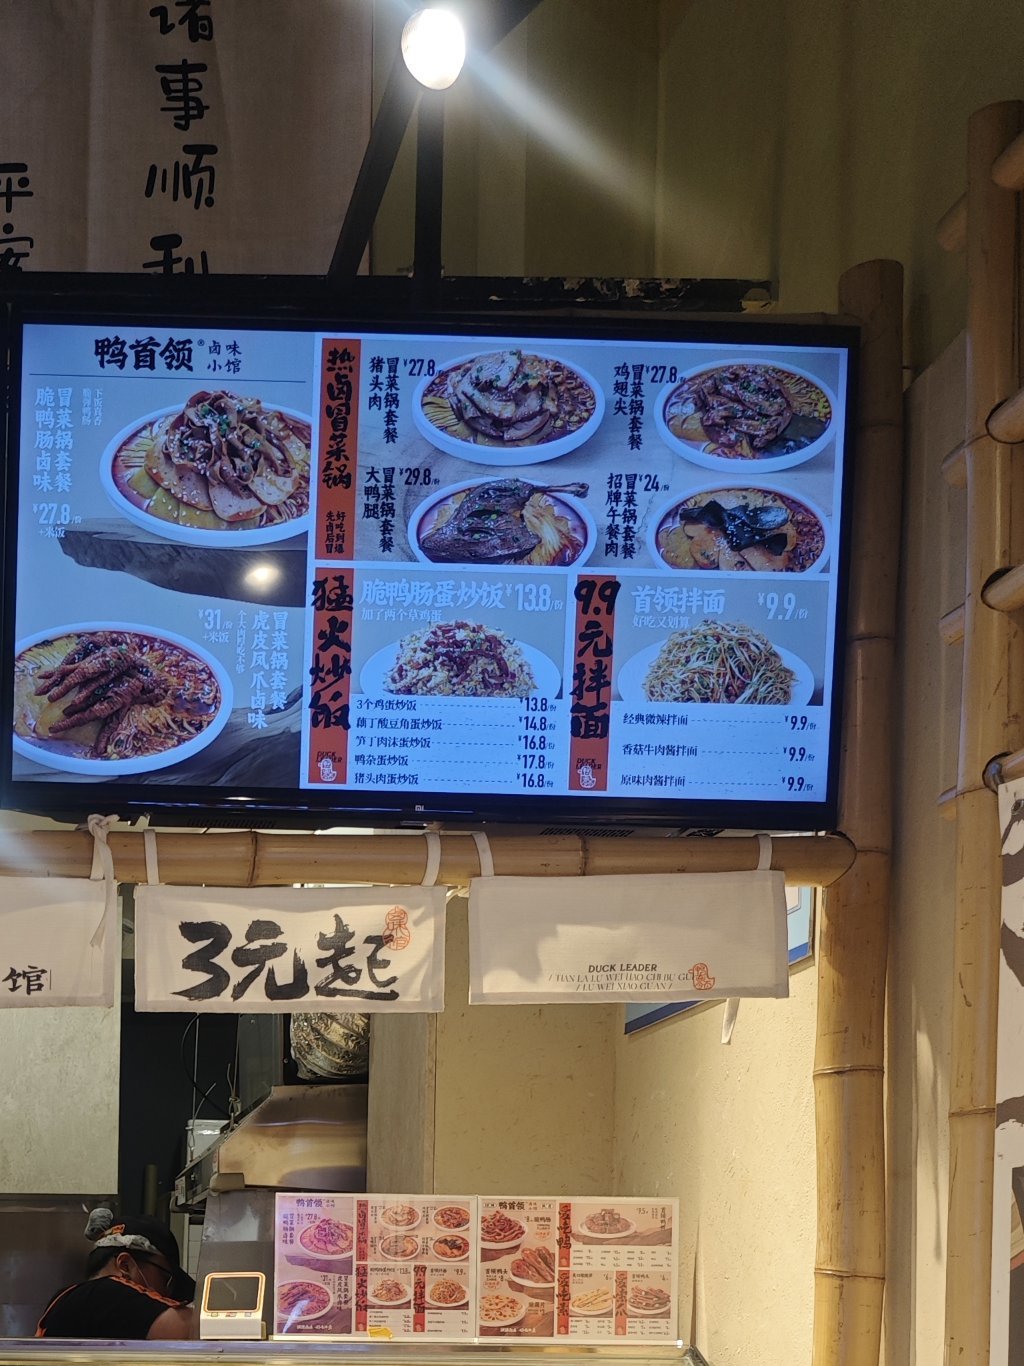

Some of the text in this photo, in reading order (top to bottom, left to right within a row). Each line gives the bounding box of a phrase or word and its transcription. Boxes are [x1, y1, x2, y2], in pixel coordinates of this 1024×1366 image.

[94, 335, 194, 372] 鸭首领
[207, 359, 242, 374] 小馆
[208, 340, 242, 356] 卤味
[368, 356, 384, 411] 猪头肉
[383, 356, 400, 444] 冒菜锅套餐
[613, 362, 630, 416] 鸡翅尖
[628, 363, 645, 450] 冒菜锅套餐
[33, 387, 55, 492] 脆鸭肠卤味
[54, 387, 74, 492] 冒菜锅套餐
[322, 348, 355, 490] 热卤冒菜锅
[362, 467, 382, 520] 大鸭腿
[379, 467, 396, 553] 冒菜锅套餐
[605, 473, 623, 558] 招牌午餐肉
[621, 473, 639, 560] 冒菜锅套餐
[359, 578, 506, 609] 脆鸭肠蛋炒饭
[632, 585, 725, 615] 首领拌面
[632, 614, 690, 629] 好吃又划算
[248, 610, 270, 729] 虎皮凤爪卤味
[270, 611, 289, 710] 冒菜锅套餐
[308, 575, 353, 730] 猛火炒饭
[356, 699, 417, 712] 3个鸡蛋炒饭
[623, 712, 688, 726] 经典微辣拌面
[354, 754, 408, 767] 鸭杂蛋炒饭
[622, 744, 698, 757] 香菇牛肉酱拌面
[355, 772, 419, 785] 猪头肉蛋炒饭
[621, 774, 686, 788] 原味肉酱拌面
[171, 914, 400, 1002] 3元起
[588, 964, 657, 973] DUCK LEADER
